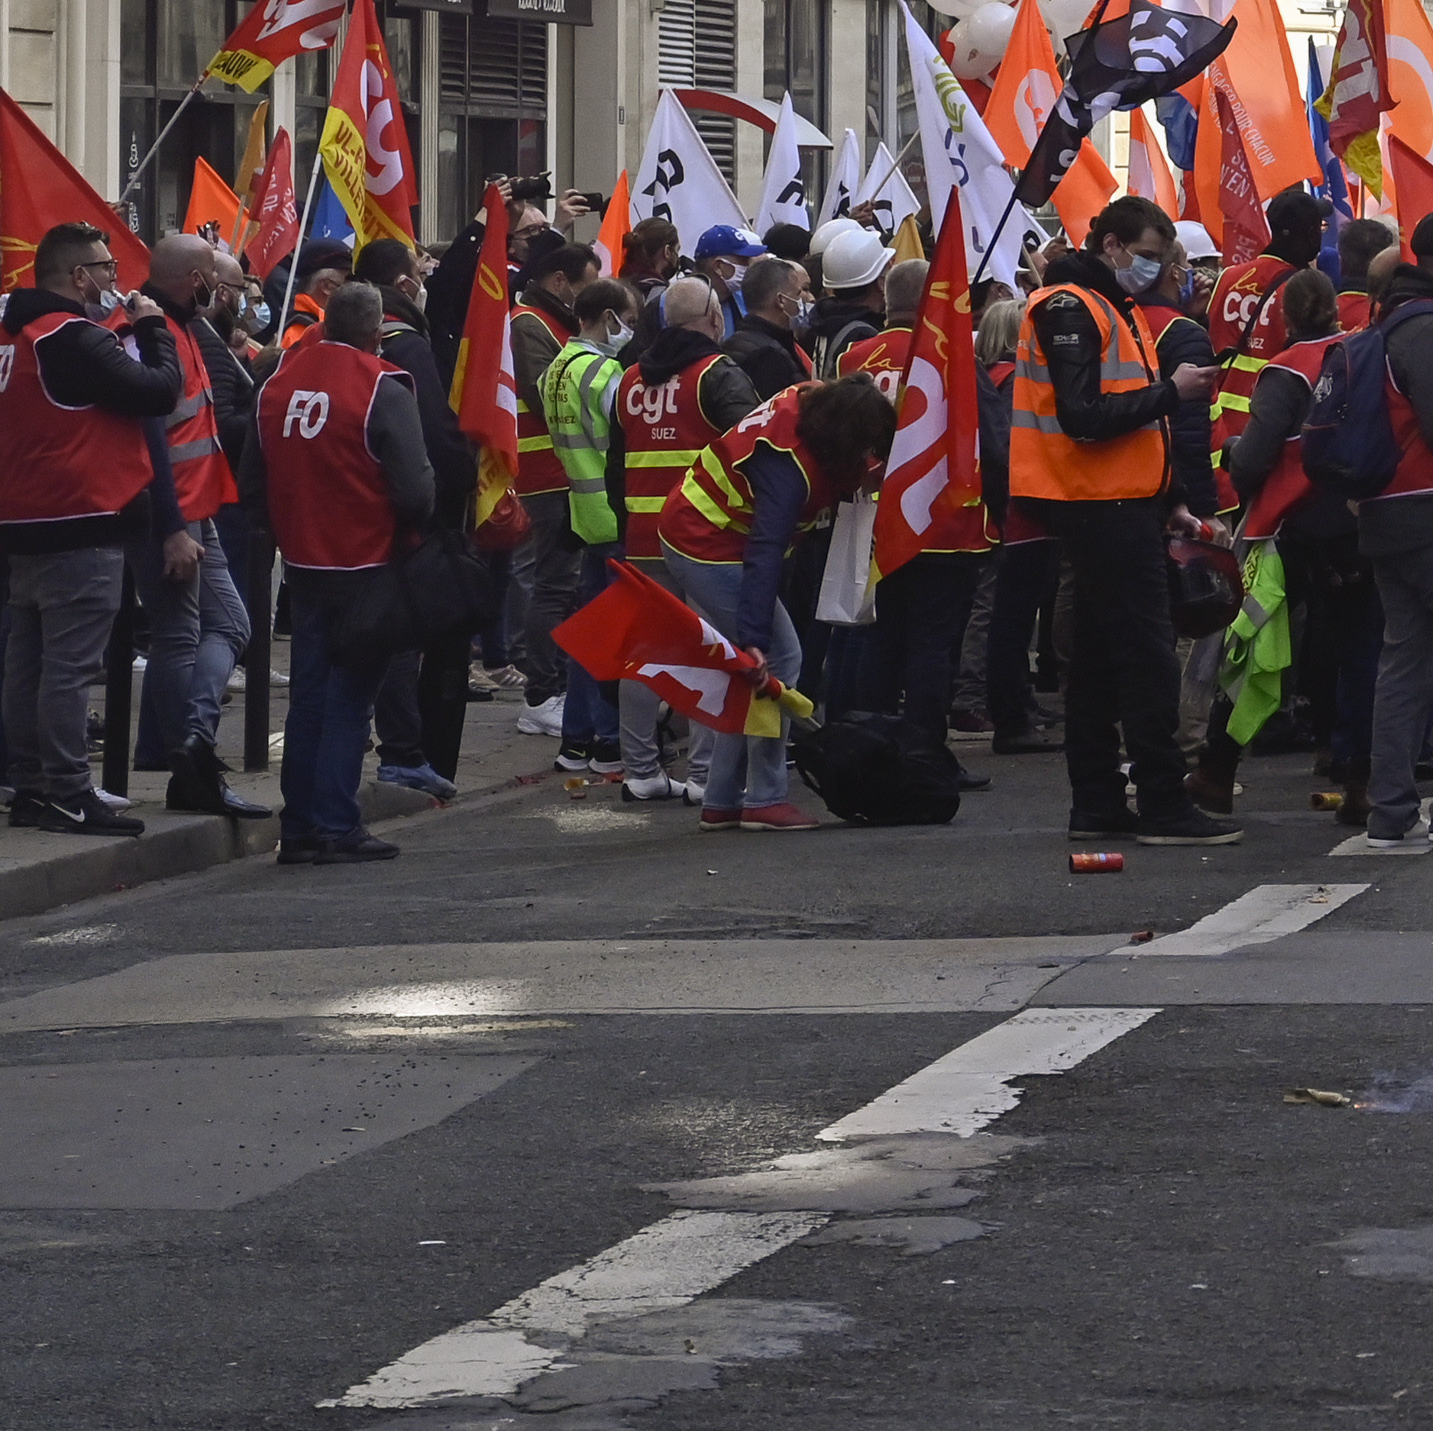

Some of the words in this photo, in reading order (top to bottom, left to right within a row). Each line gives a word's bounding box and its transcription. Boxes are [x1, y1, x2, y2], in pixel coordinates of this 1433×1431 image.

[1243, 128, 1276, 167] CHACUN
[282, 390, 328, 438] FO
[626, 374, 681, 425] cgt
[651, 427, 676, 440] SUEZ
